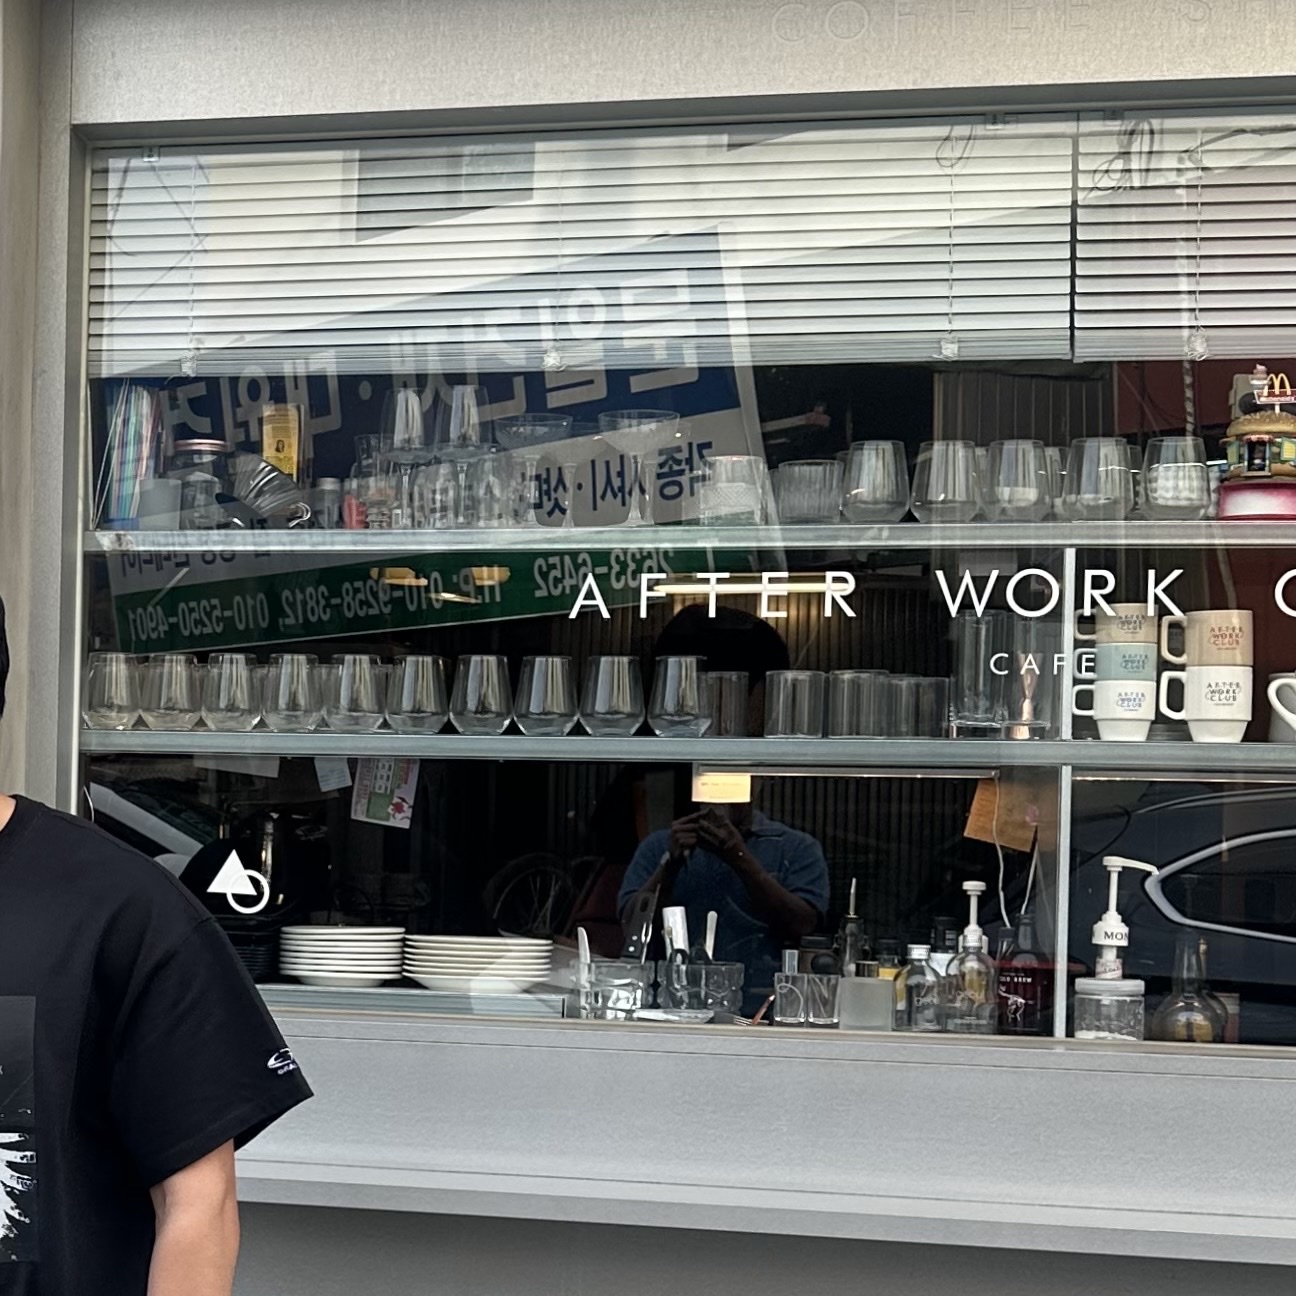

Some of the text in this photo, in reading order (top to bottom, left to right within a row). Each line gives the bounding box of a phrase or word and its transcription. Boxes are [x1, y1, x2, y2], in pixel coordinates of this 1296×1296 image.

[570, 570, 856, 619] AFTER
[935, 568, 1184, 618] WORK
[990, 654, 1095, 677] CAFE
